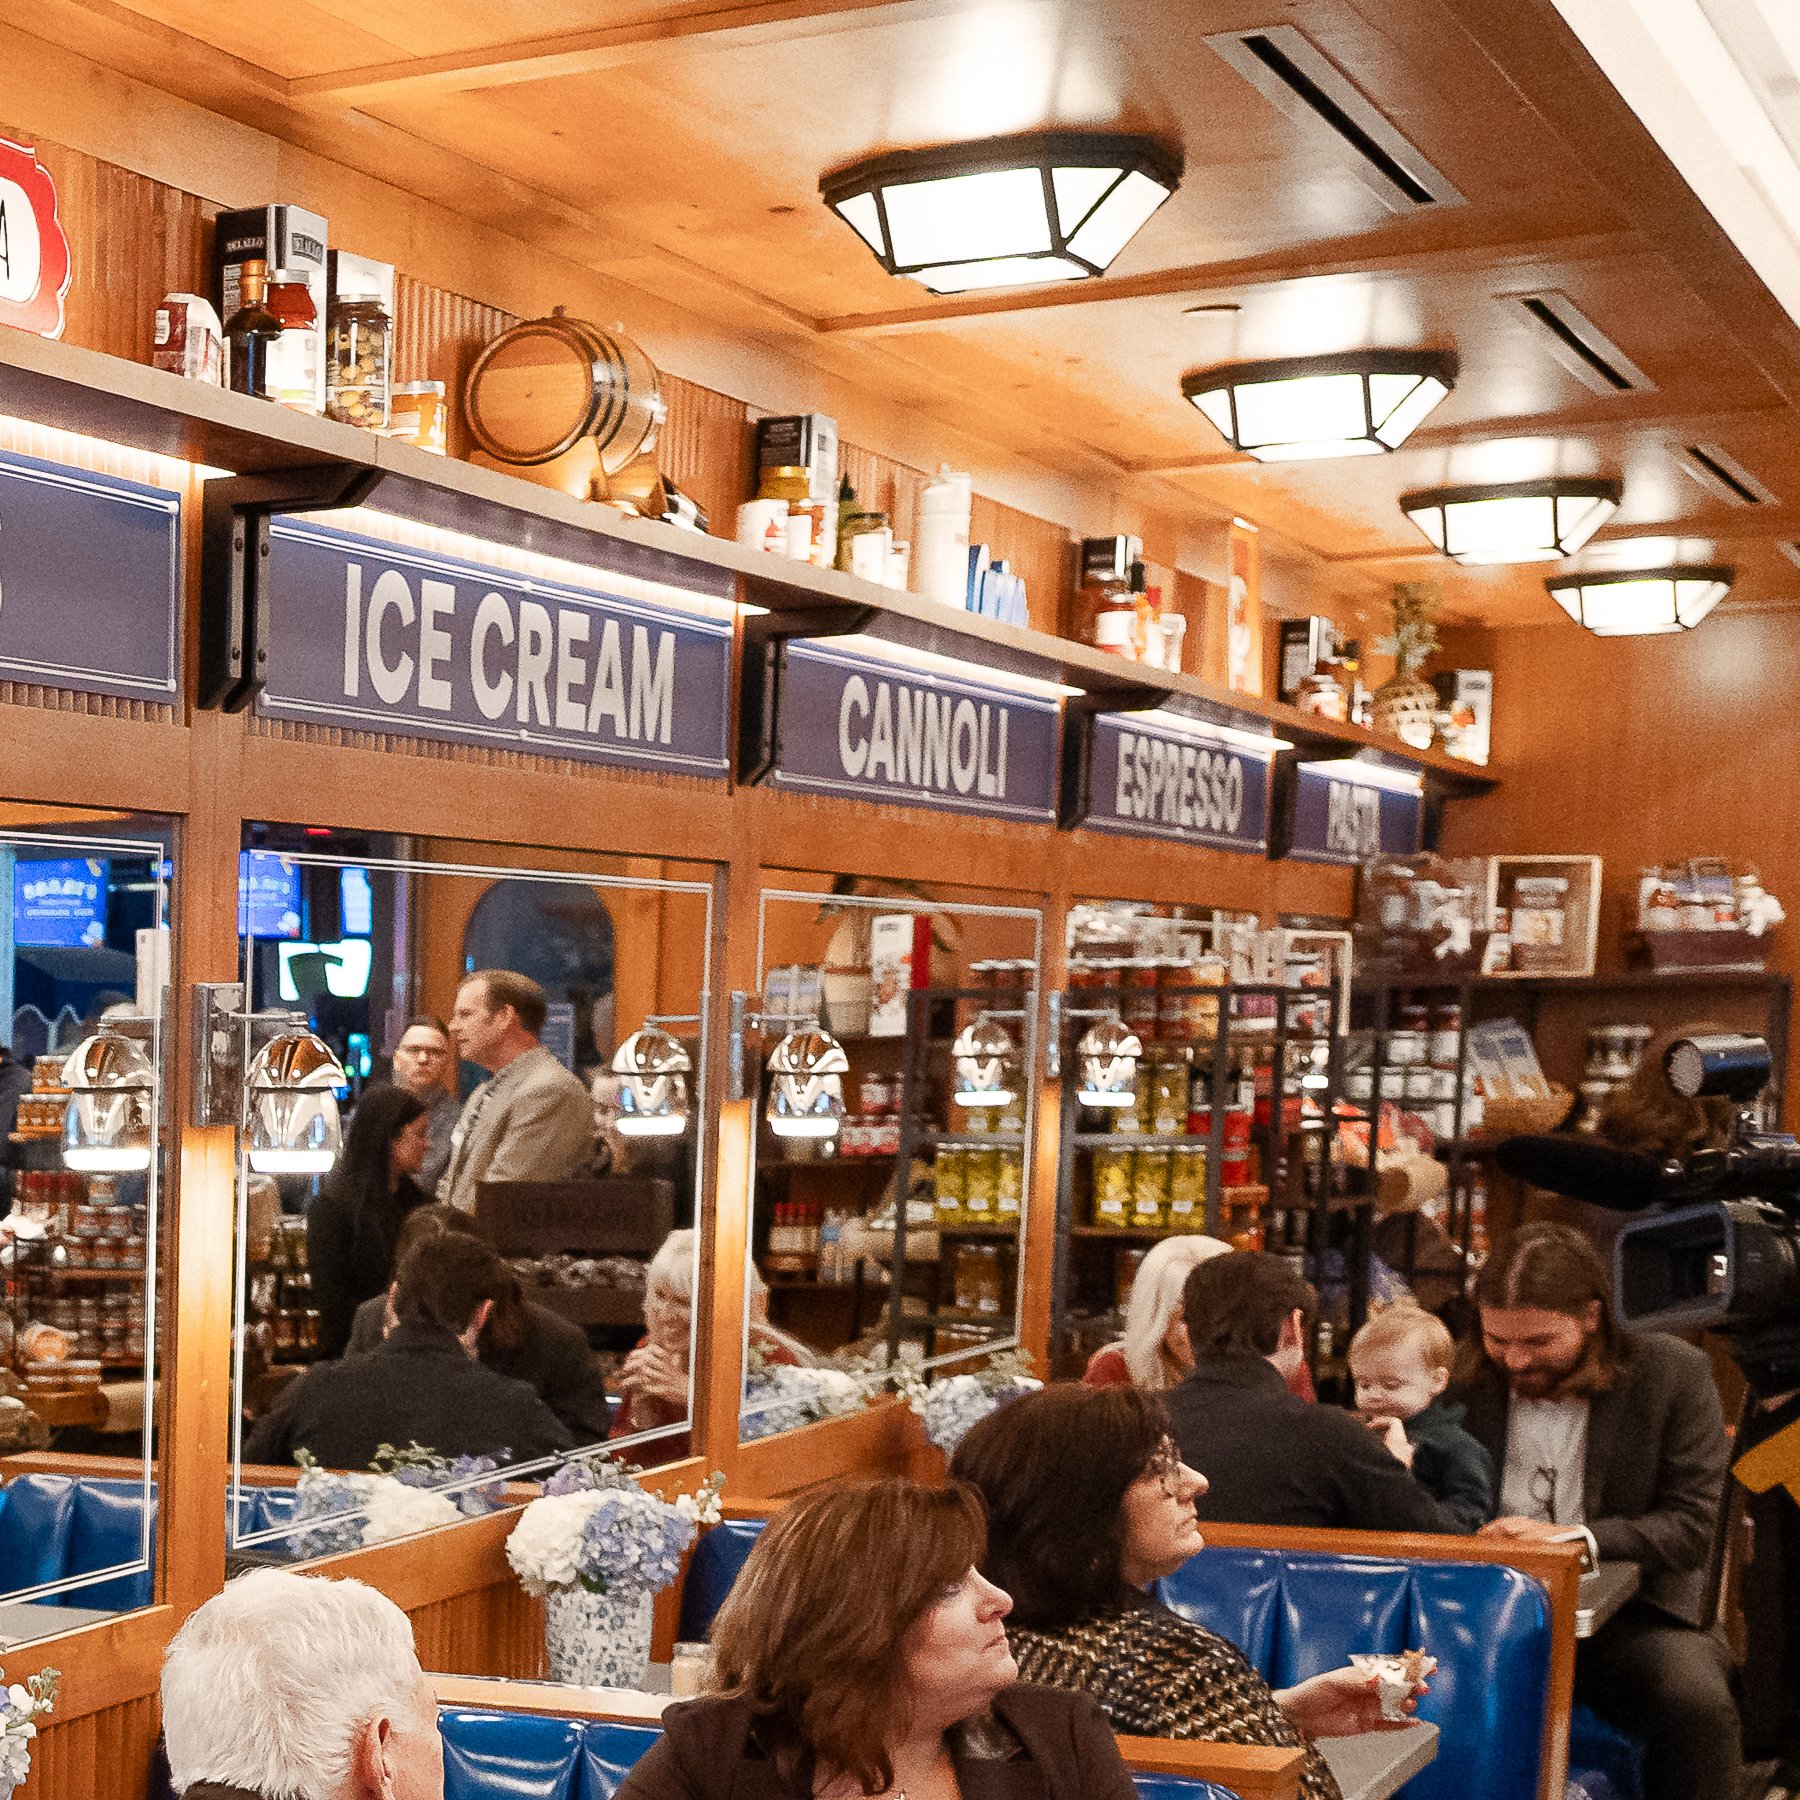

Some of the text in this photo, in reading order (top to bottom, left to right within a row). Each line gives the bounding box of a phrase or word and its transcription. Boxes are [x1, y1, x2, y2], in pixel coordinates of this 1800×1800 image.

[344, 562, 677, 744] ICE CREAM
[838, 674, 1010, 799] CANNOLI
[1116, 731, 1243, 834] ESPRESSO
